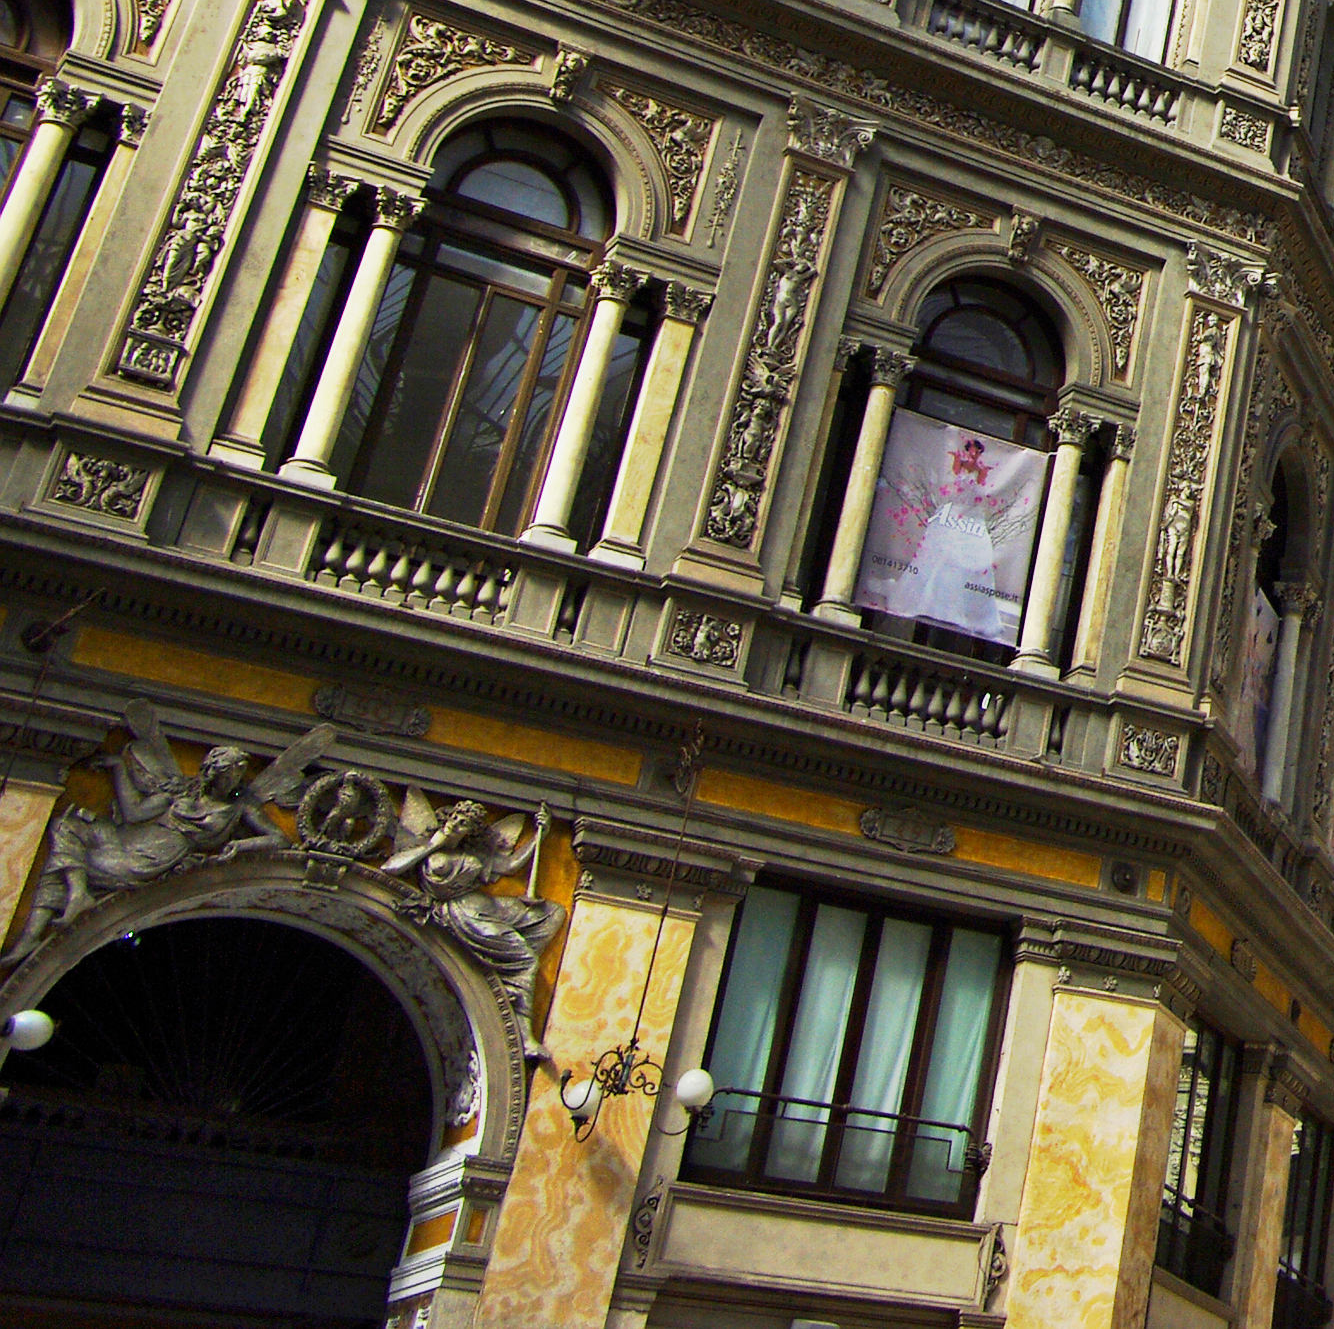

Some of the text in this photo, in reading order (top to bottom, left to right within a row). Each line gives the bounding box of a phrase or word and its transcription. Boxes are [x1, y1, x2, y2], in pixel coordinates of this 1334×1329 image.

[927, 502, 986, 539] Assia
[871, 554, 919, 576] 081413710
[964, 581, 1019, 603] assiaspose.it
